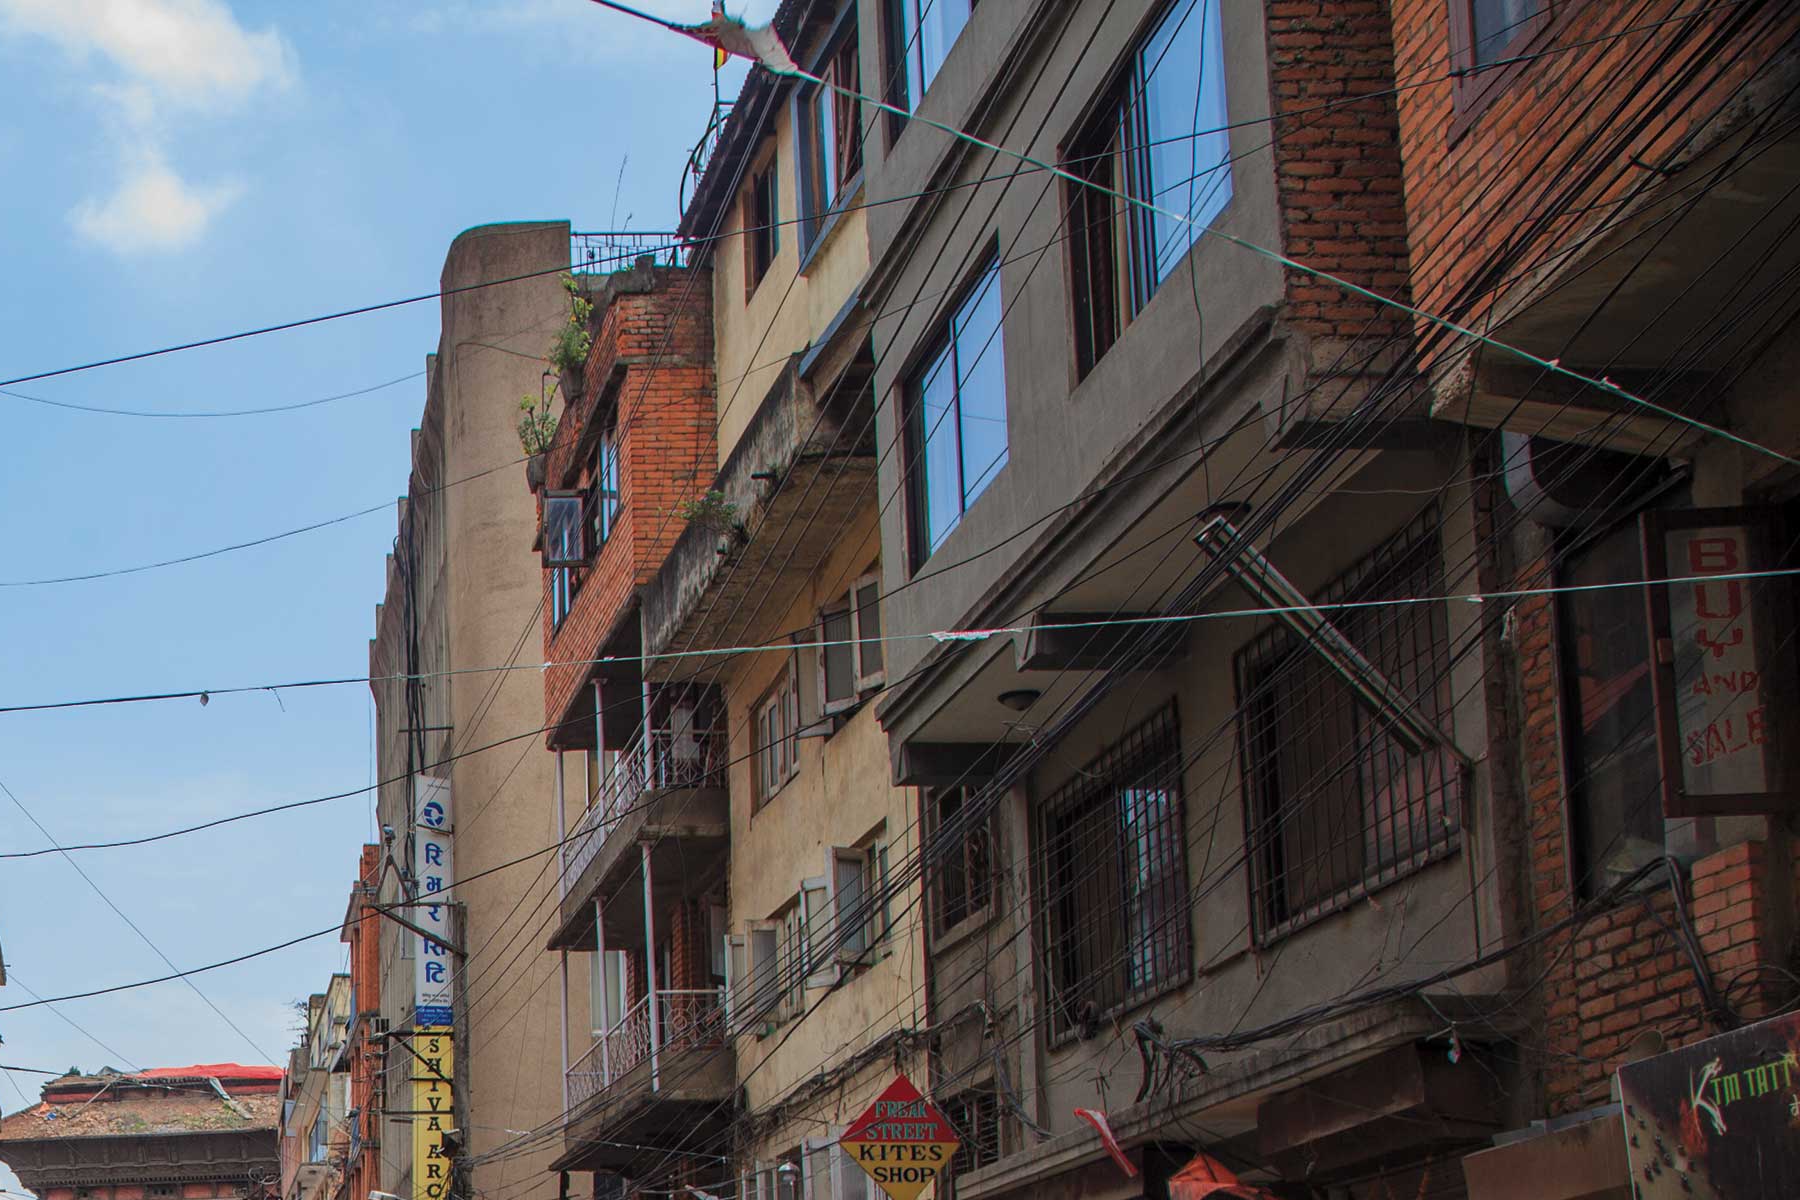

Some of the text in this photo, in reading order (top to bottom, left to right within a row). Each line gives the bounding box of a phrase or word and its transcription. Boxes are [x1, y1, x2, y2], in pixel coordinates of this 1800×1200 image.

[1686, 705, 1770, 767] SALE
[874, 1100, 928, 1118] FREAK
[865, 1122, 938, 1140] STREET
[858, 1143, 943, 1161] KITES
[873, 1166, 936, 1184] SHOP
